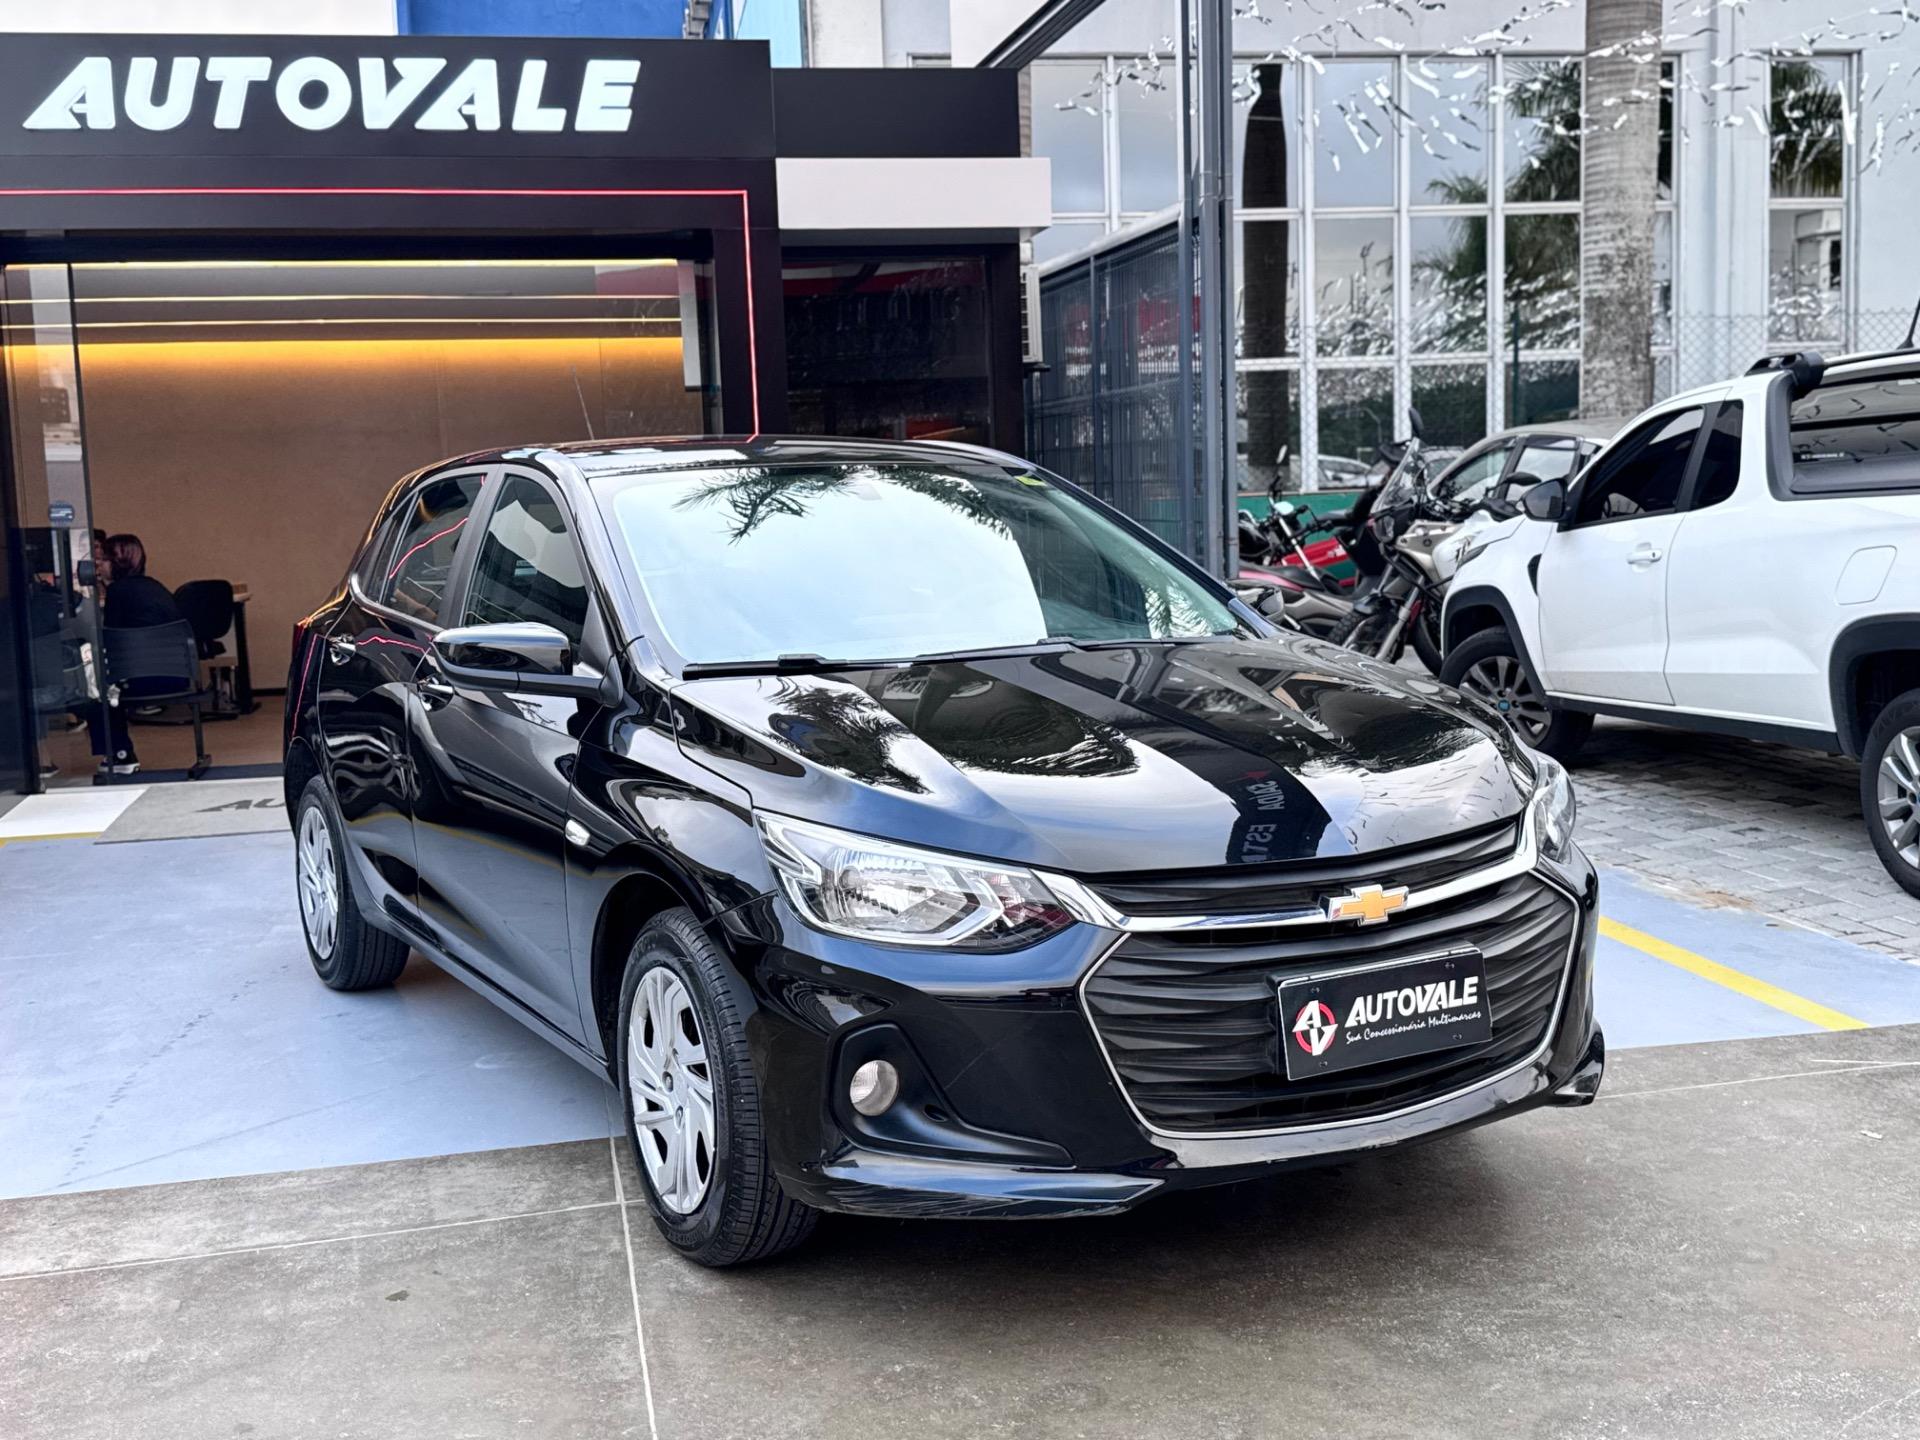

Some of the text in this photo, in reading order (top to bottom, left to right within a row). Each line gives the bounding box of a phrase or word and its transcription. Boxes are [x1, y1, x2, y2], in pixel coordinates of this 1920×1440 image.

[22, 55, 641, 132] AUTOVALE
[1344, 975, 1479, 1028] AUTOVALE
[1346, 1011, 1482, 1045] Sua Concessionária Multimarcas
